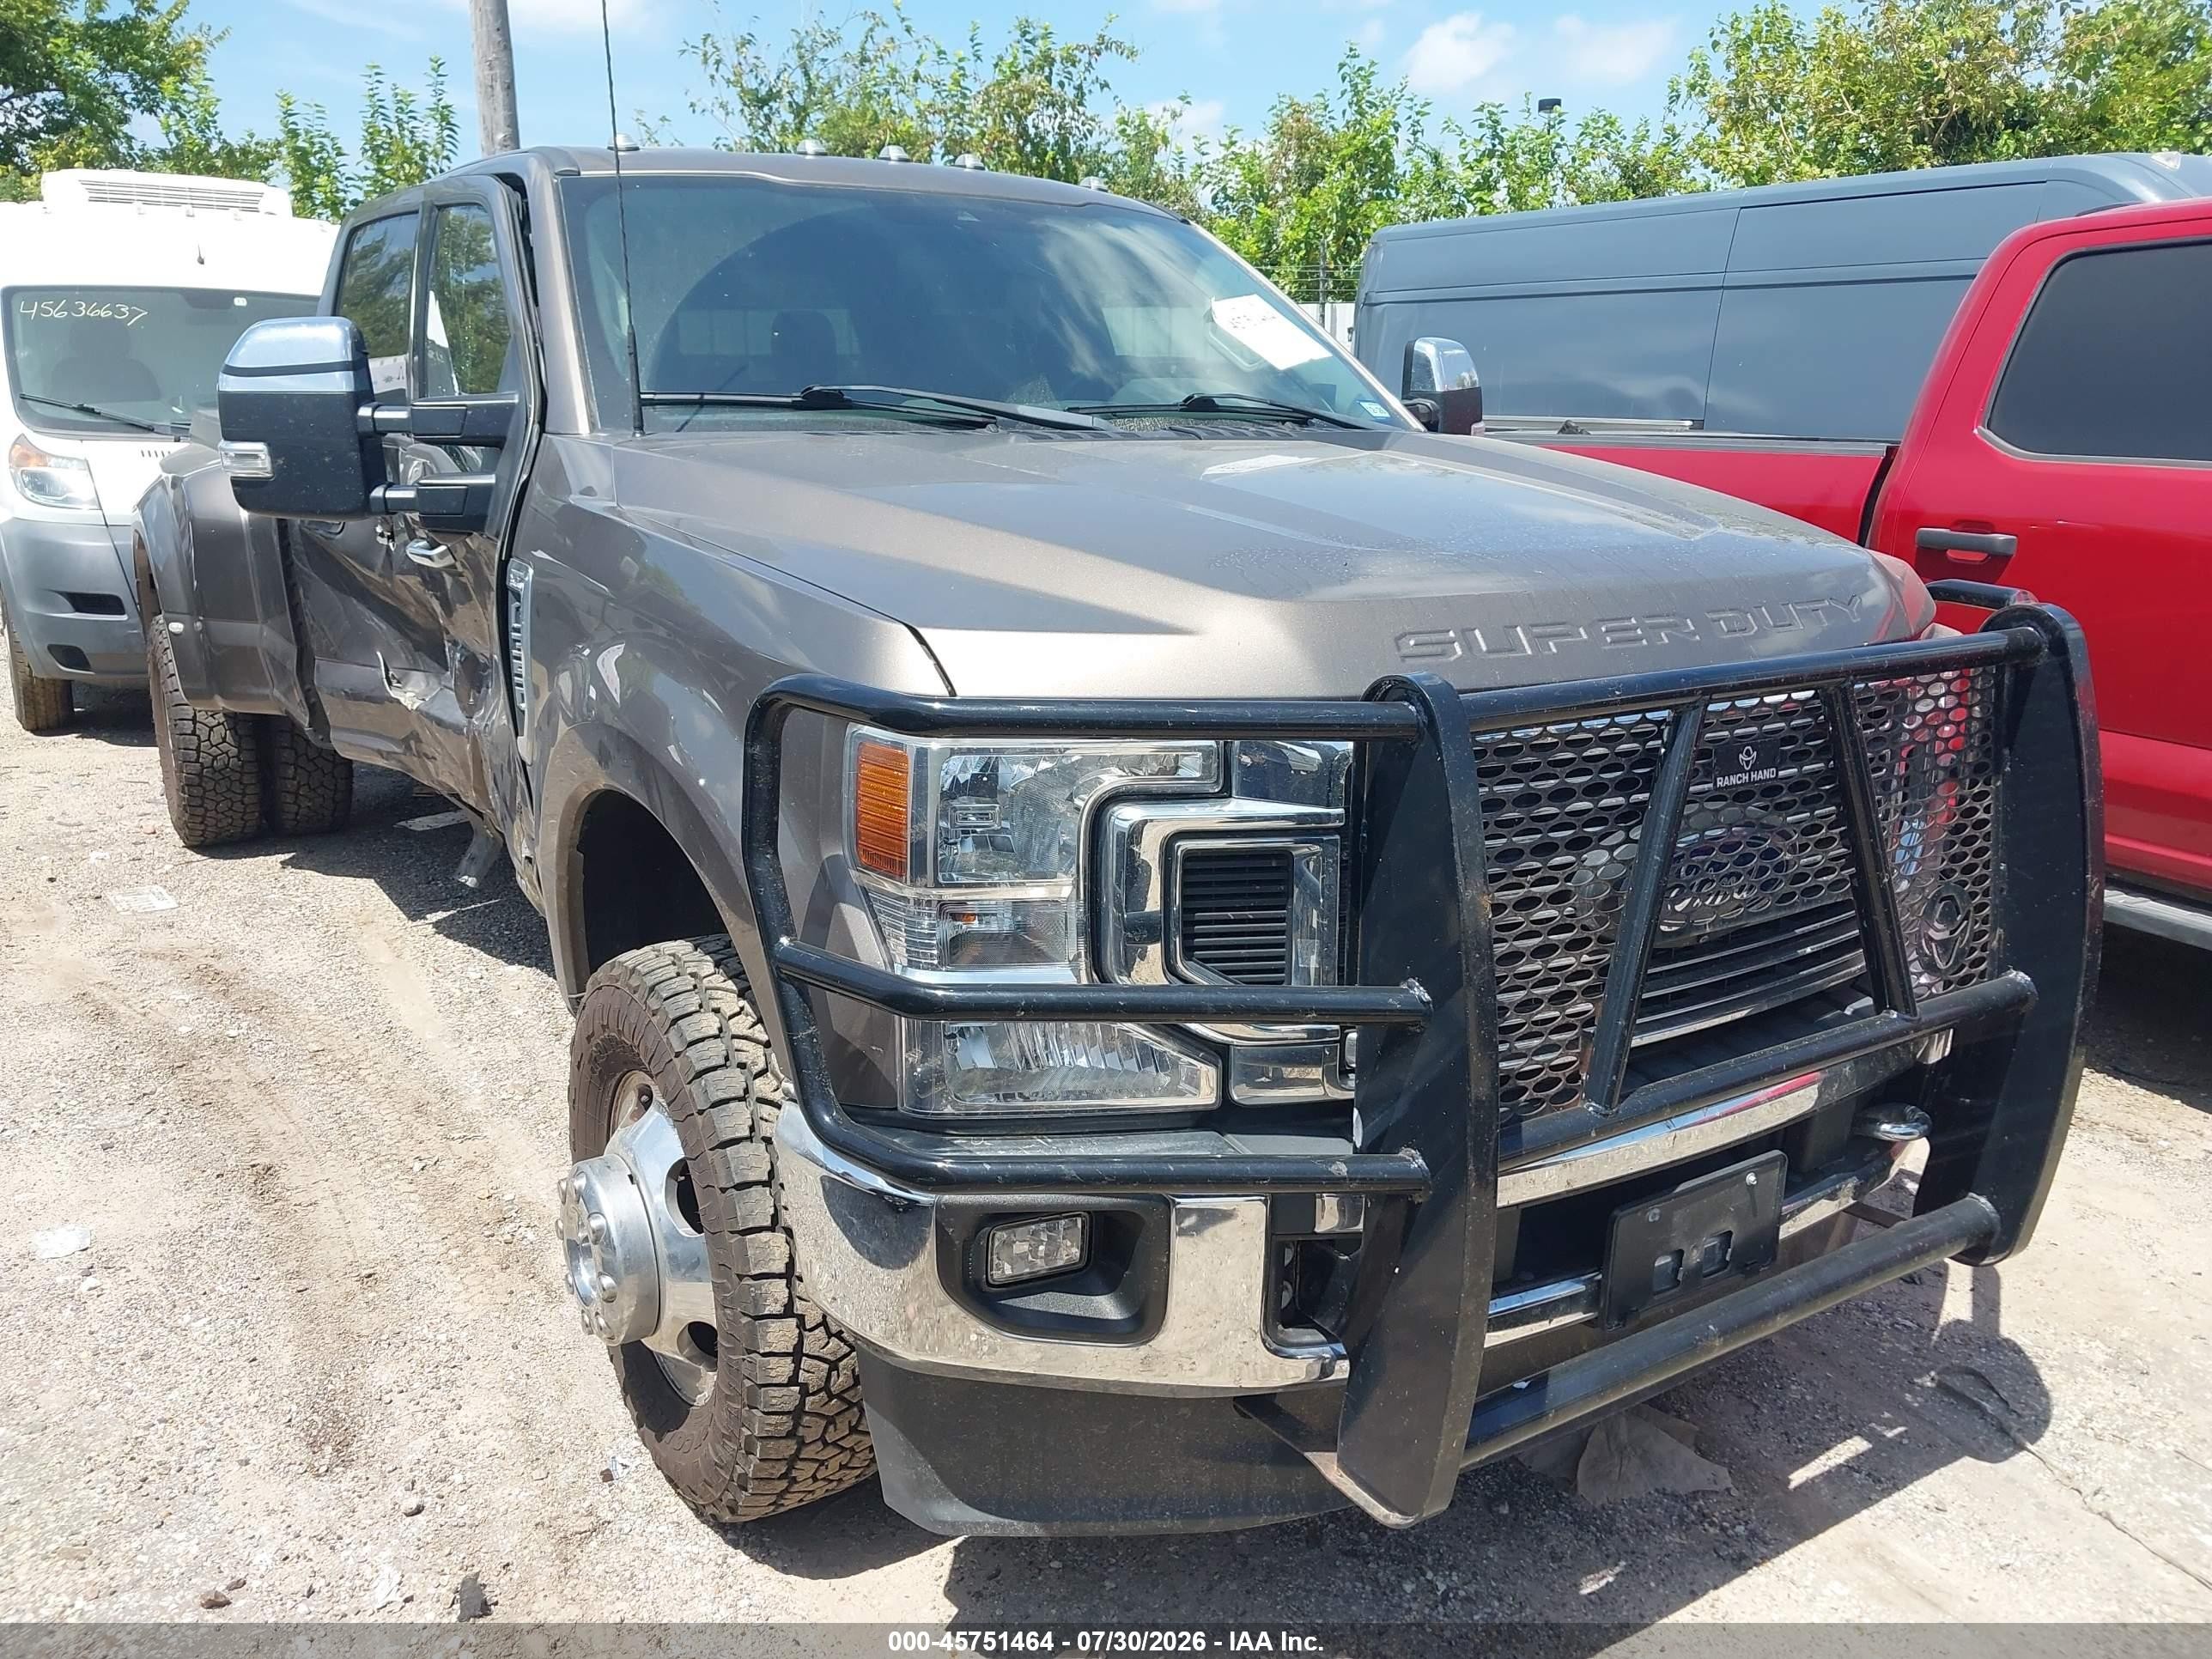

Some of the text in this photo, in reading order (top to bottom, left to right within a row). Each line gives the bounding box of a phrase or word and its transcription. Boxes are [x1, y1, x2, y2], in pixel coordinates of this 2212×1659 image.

[19, 300, 149, 326] 45636637
[1395, 593, 1863, 664] SUPER DUTY
[1717, 767, 1777, 788] RANCH HAND
